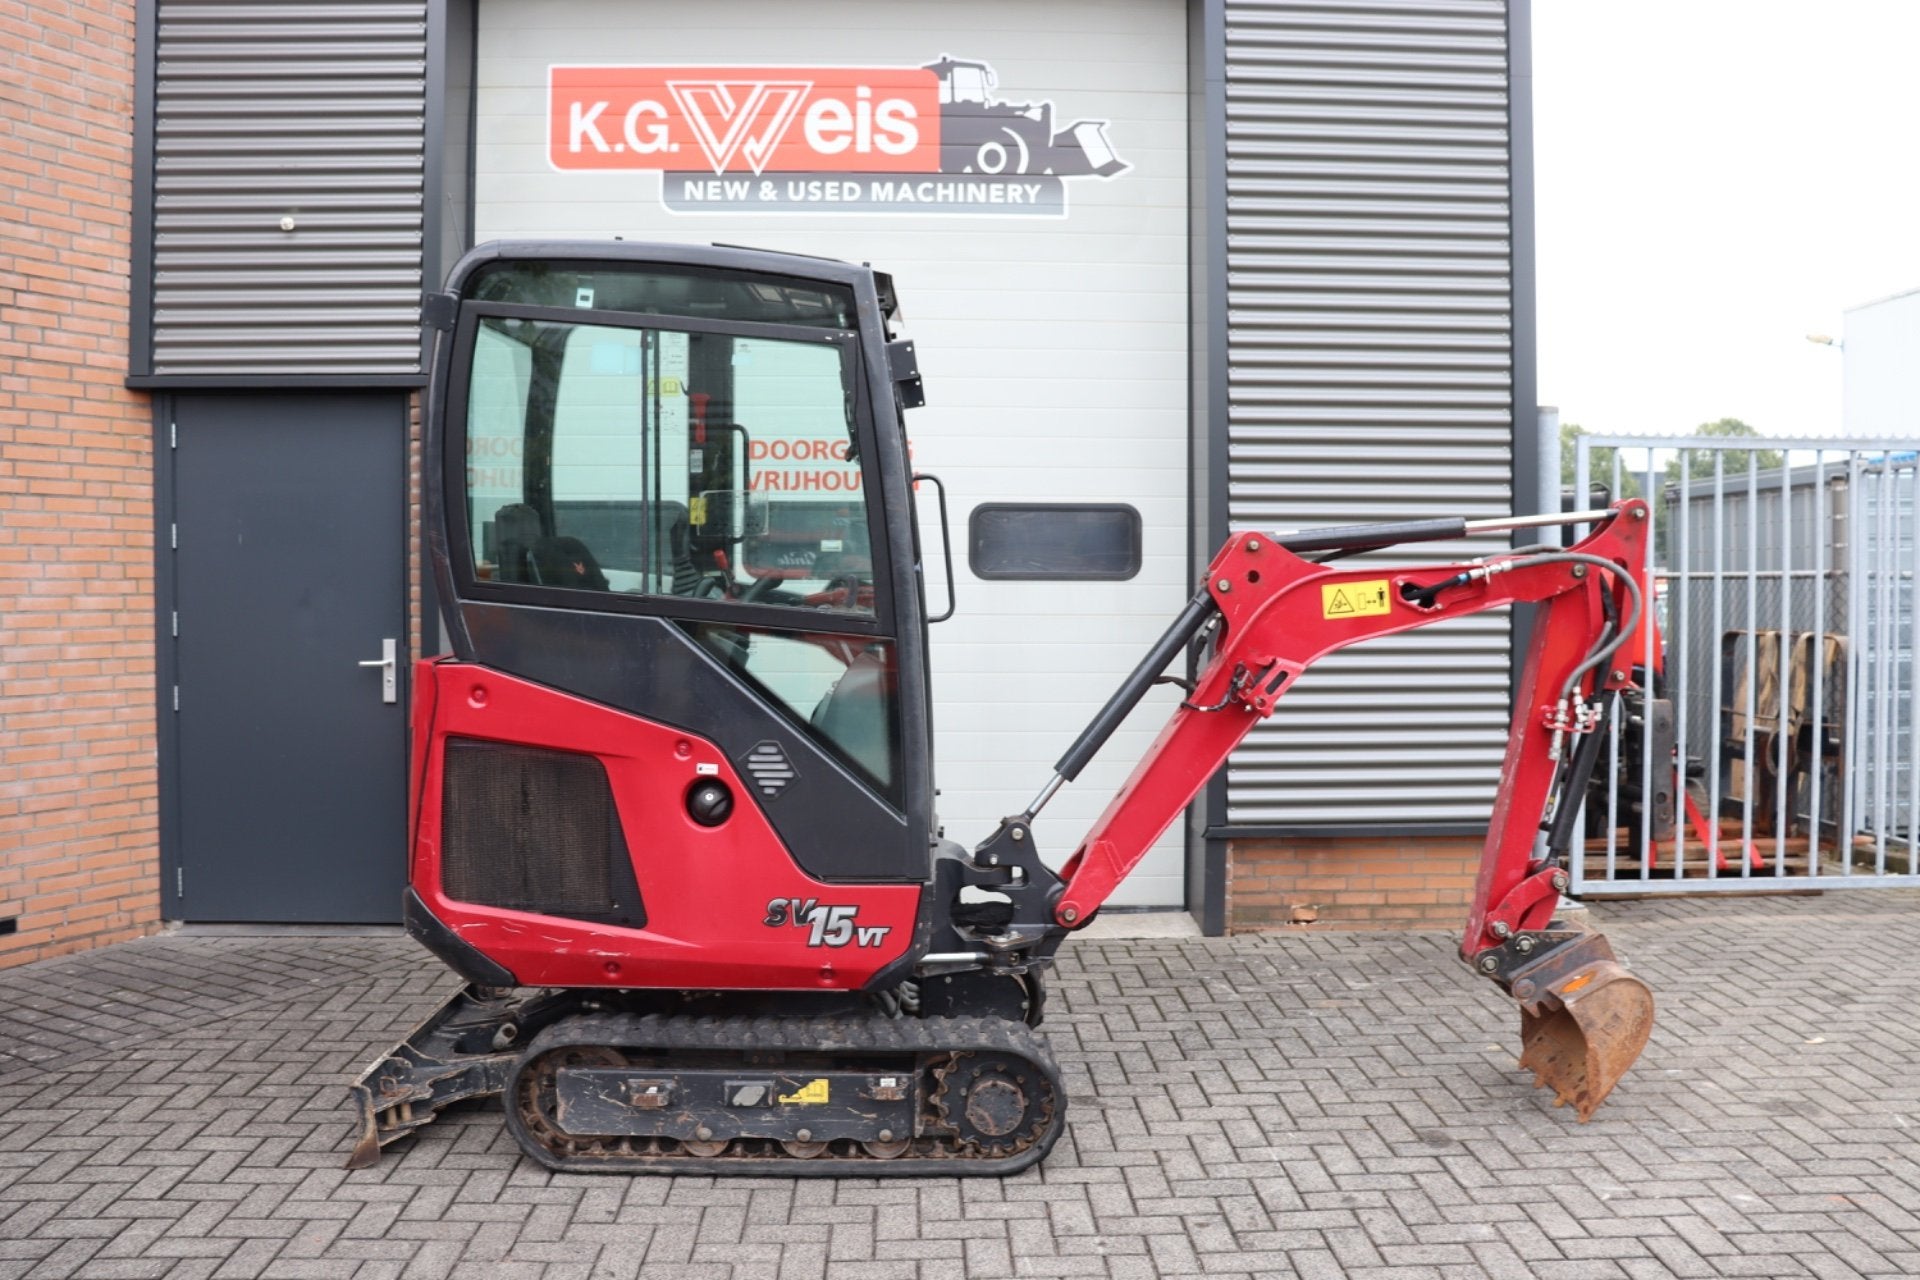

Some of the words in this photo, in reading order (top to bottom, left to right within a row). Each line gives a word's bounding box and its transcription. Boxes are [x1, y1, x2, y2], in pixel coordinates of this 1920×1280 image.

[569, 100, 680, 154] K.G.
[665, 80, 919, 177] Weis
[684, 180, 750, 201] NEW
[758, 180, 778, 201] &
[787, 180, 862, 202] USED
[870, 181, 1042, 204] MACHINERY
